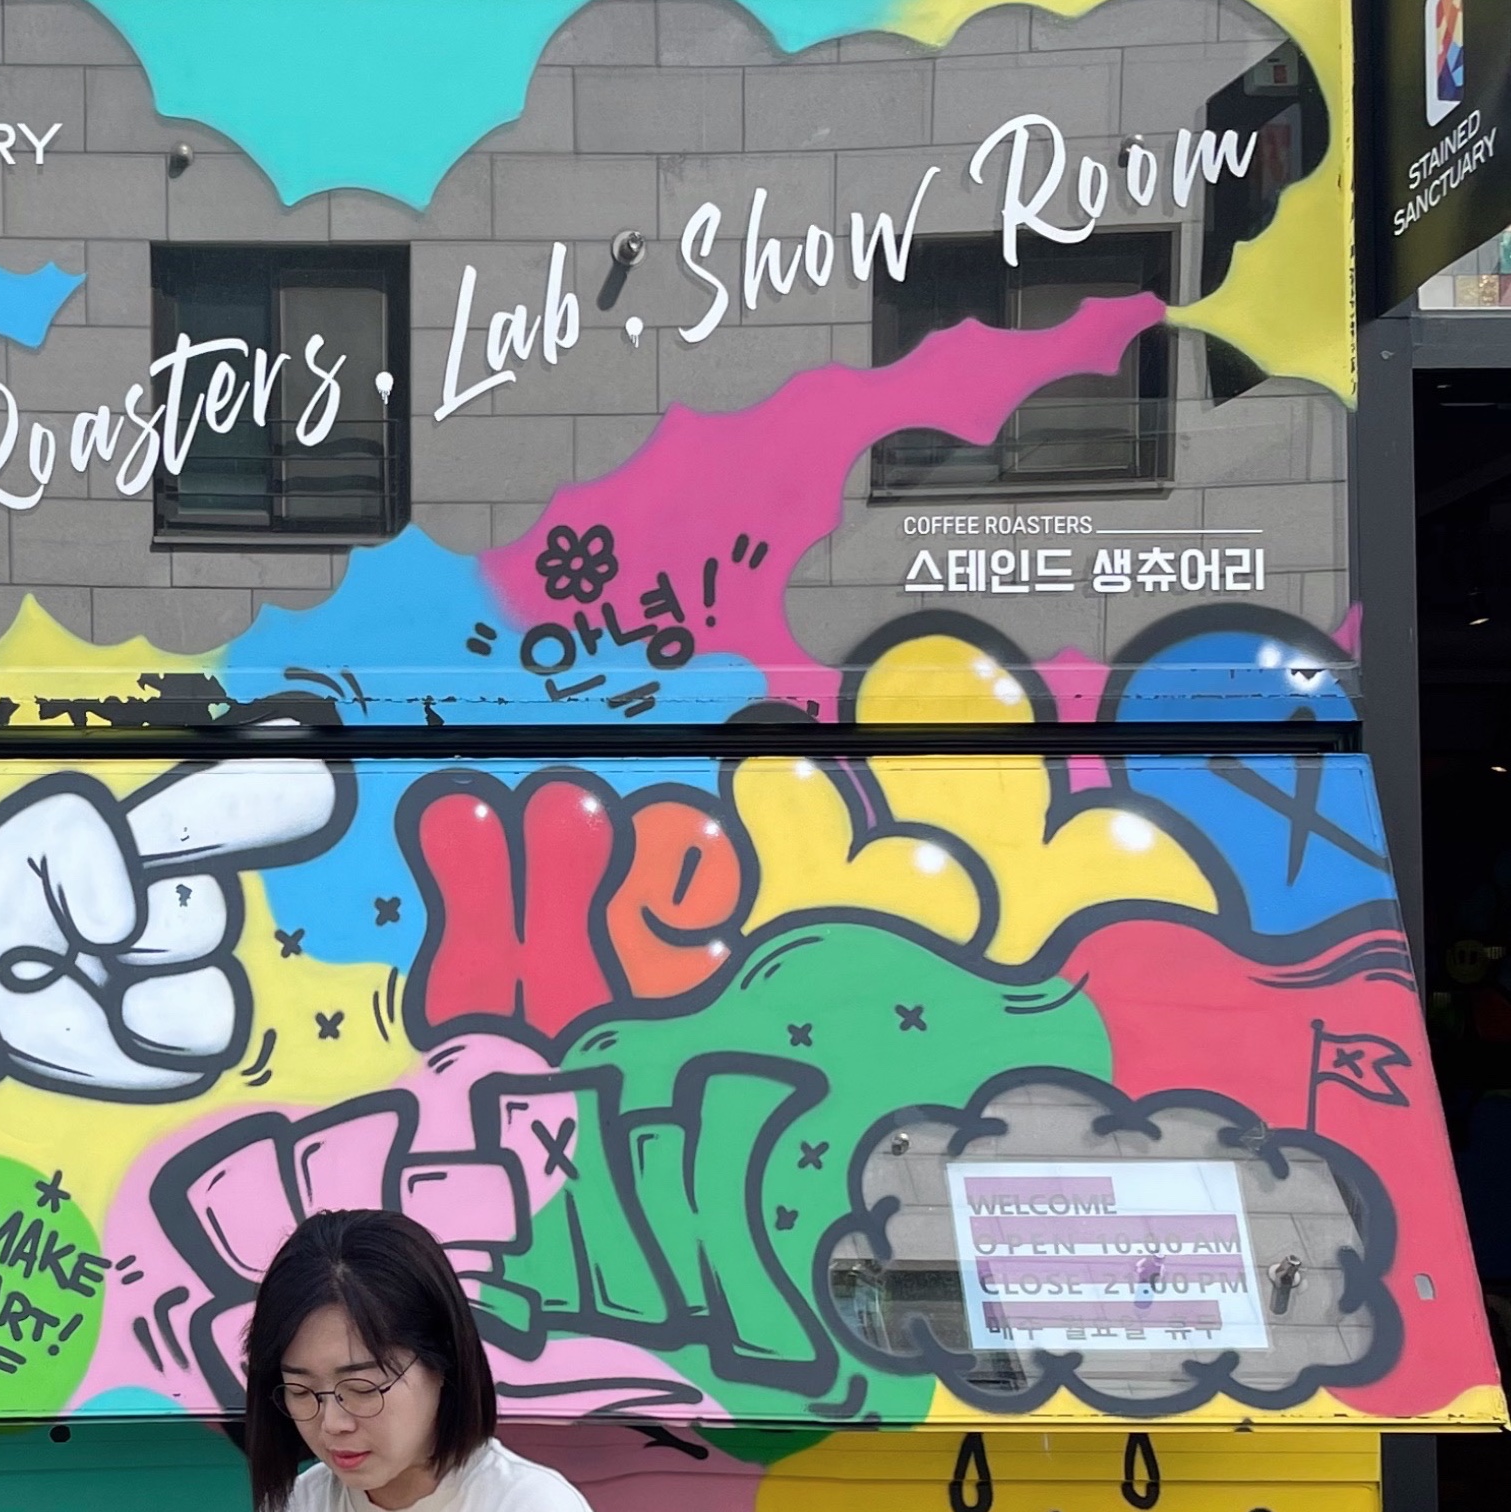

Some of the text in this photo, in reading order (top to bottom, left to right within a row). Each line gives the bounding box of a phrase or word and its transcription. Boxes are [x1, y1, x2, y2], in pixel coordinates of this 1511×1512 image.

[1408, 109, 1481, 190] STAINED
[1393, 126, 1497, 237] SANCTUARY
[676, 164, 943, 343] Show
[968, 112, 1260, 268] Room
[903, 515, 1094, 536] COFFEE ROASTERS
[903, 545, 1265, 594] 스테인드 생츄어리
[968, 1193, 1118, 1216] WELCOME
[975, 1232, 1077, 1256] OPEN
[1191, 1232, 1243, 1255] AM
[981, 1271, 1084, 1297] CLOSE
[1199, 1271, 1250, 1296] PM
